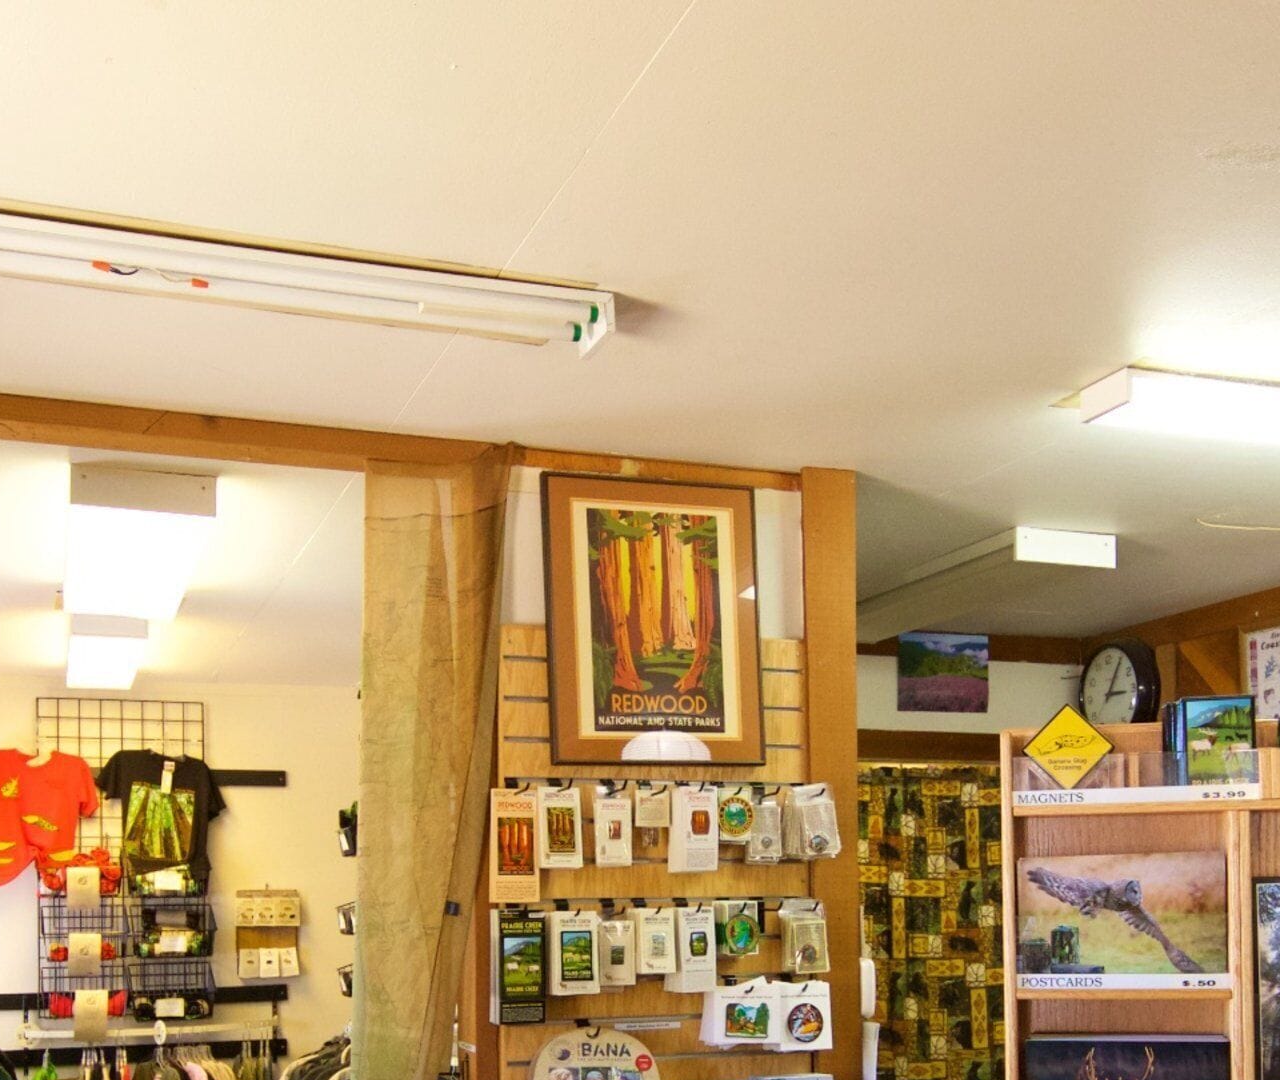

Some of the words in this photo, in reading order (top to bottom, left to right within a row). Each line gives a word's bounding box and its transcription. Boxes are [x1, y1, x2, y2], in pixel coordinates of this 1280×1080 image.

[1125, 666, 1132, 677] 2
[611, 693, 708, 715] REDWOOD
[598, 715, 643, 726] NATIONAL
[647, 716, 665, 726] AND
[668, 717, 693, 727] STATE
[695, 717, 721, 727] PARKS
[1047, 757, 1071, 765] Banana
[1072, 757, 1088, 766] Slug
[1052, 764, 1083, 772] Crossing
[1017, 791, 1085, 804] MAGNETS
[1202, 790, 1247, 799] $3.99
[1021, 977, 1103, 988] POSTCARDS
[1181, 979, 1217, 988] $.50
